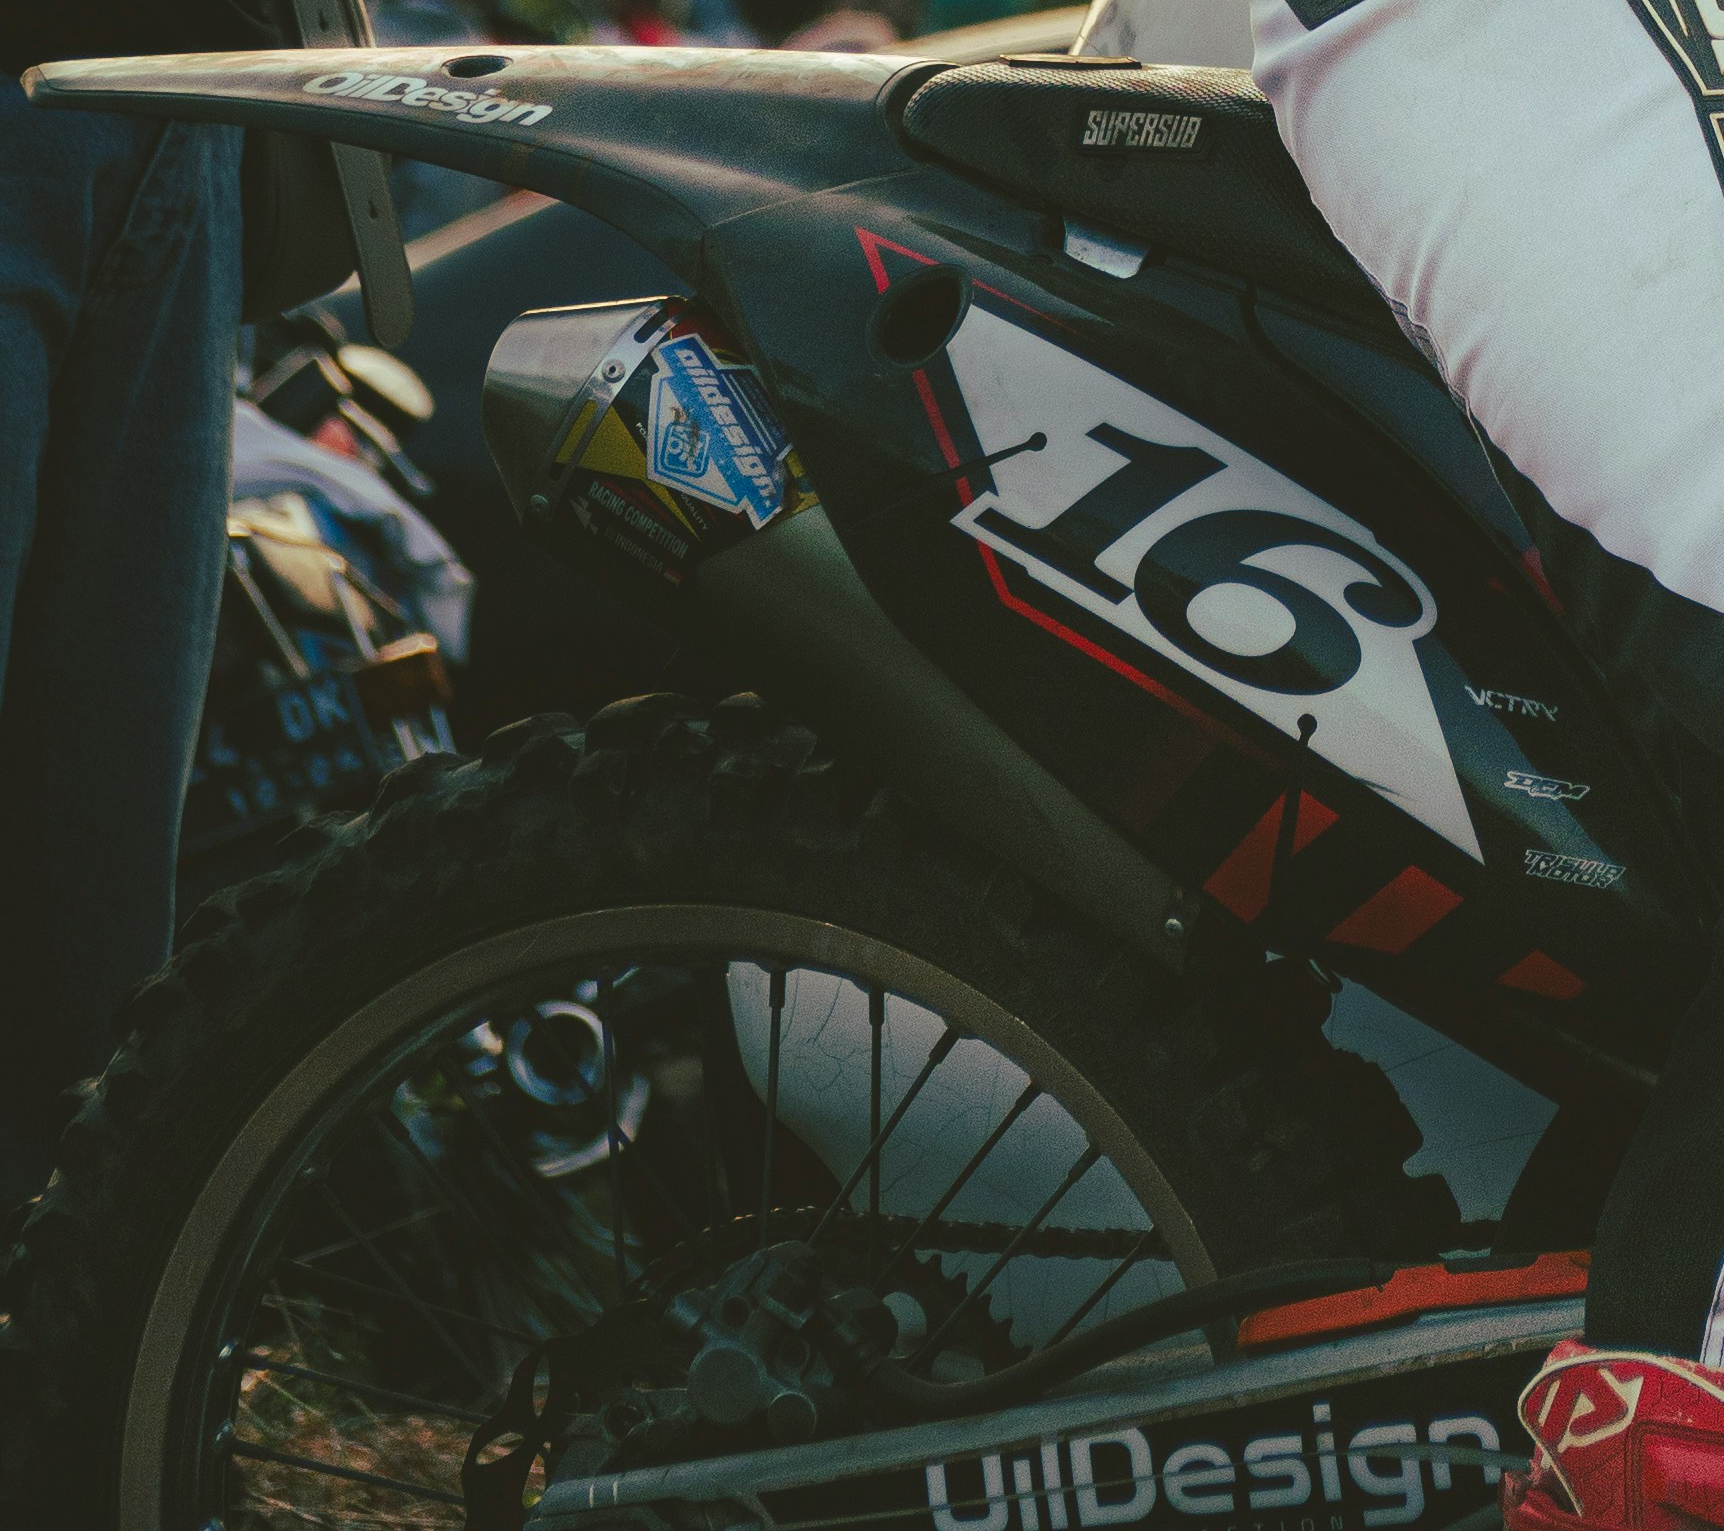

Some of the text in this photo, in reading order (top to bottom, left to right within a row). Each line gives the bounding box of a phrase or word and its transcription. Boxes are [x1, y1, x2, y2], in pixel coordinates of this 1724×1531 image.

[303, 72, 553, 127] OilDesign
[588, 481, 690, 560] RACING COMPETITION
[972, 422, 1425, 697] 16
